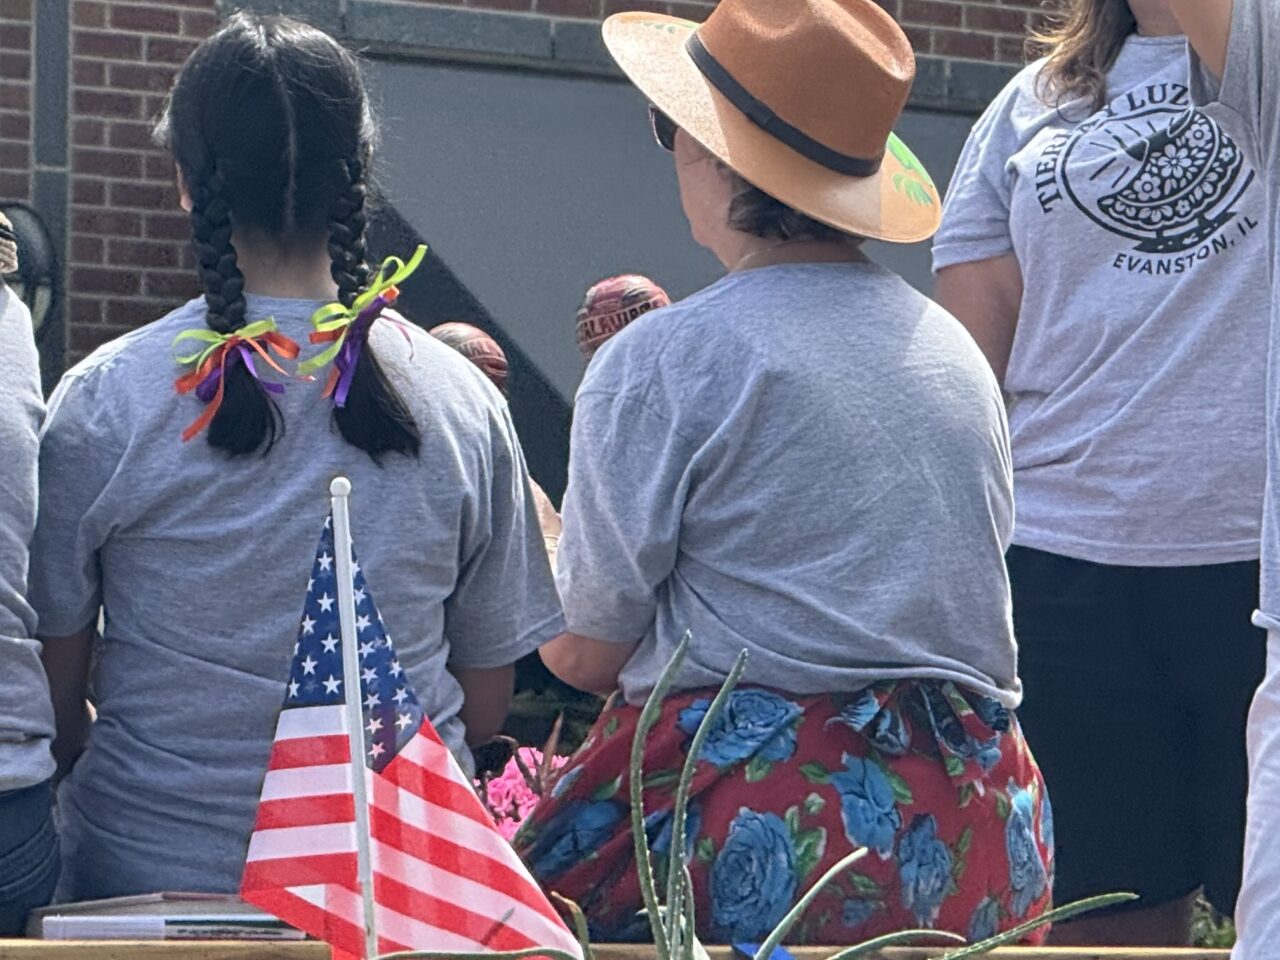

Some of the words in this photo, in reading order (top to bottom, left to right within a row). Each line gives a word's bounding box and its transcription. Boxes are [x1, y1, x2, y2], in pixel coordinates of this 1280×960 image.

[1127, 83, 1190, 111] LUZ
[1112, 233, 1235, 275] EVANSTON,
[1237, 216, 1259, 236] IL
